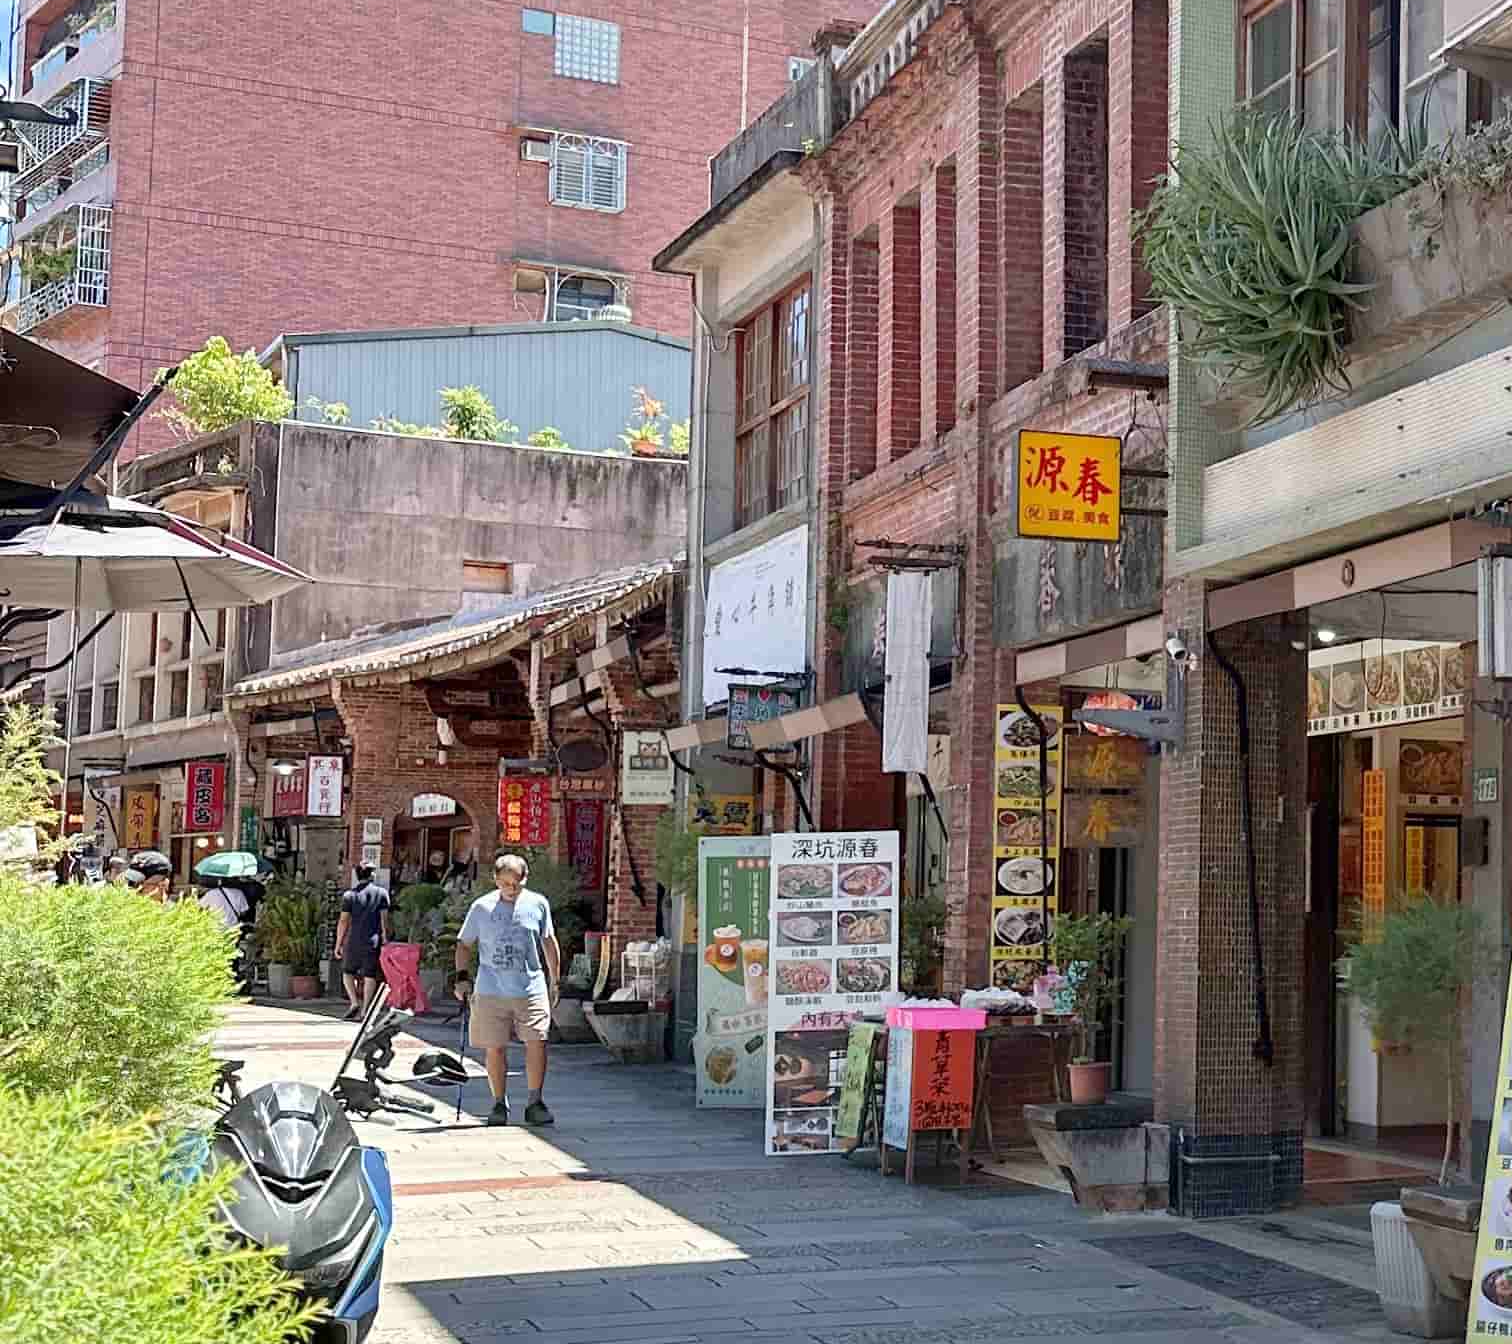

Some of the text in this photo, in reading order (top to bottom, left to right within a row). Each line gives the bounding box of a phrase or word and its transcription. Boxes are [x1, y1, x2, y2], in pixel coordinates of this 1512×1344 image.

[1025, 445, 1113, 507] 源春
[792, 838, 880, 859] 深坑源春
